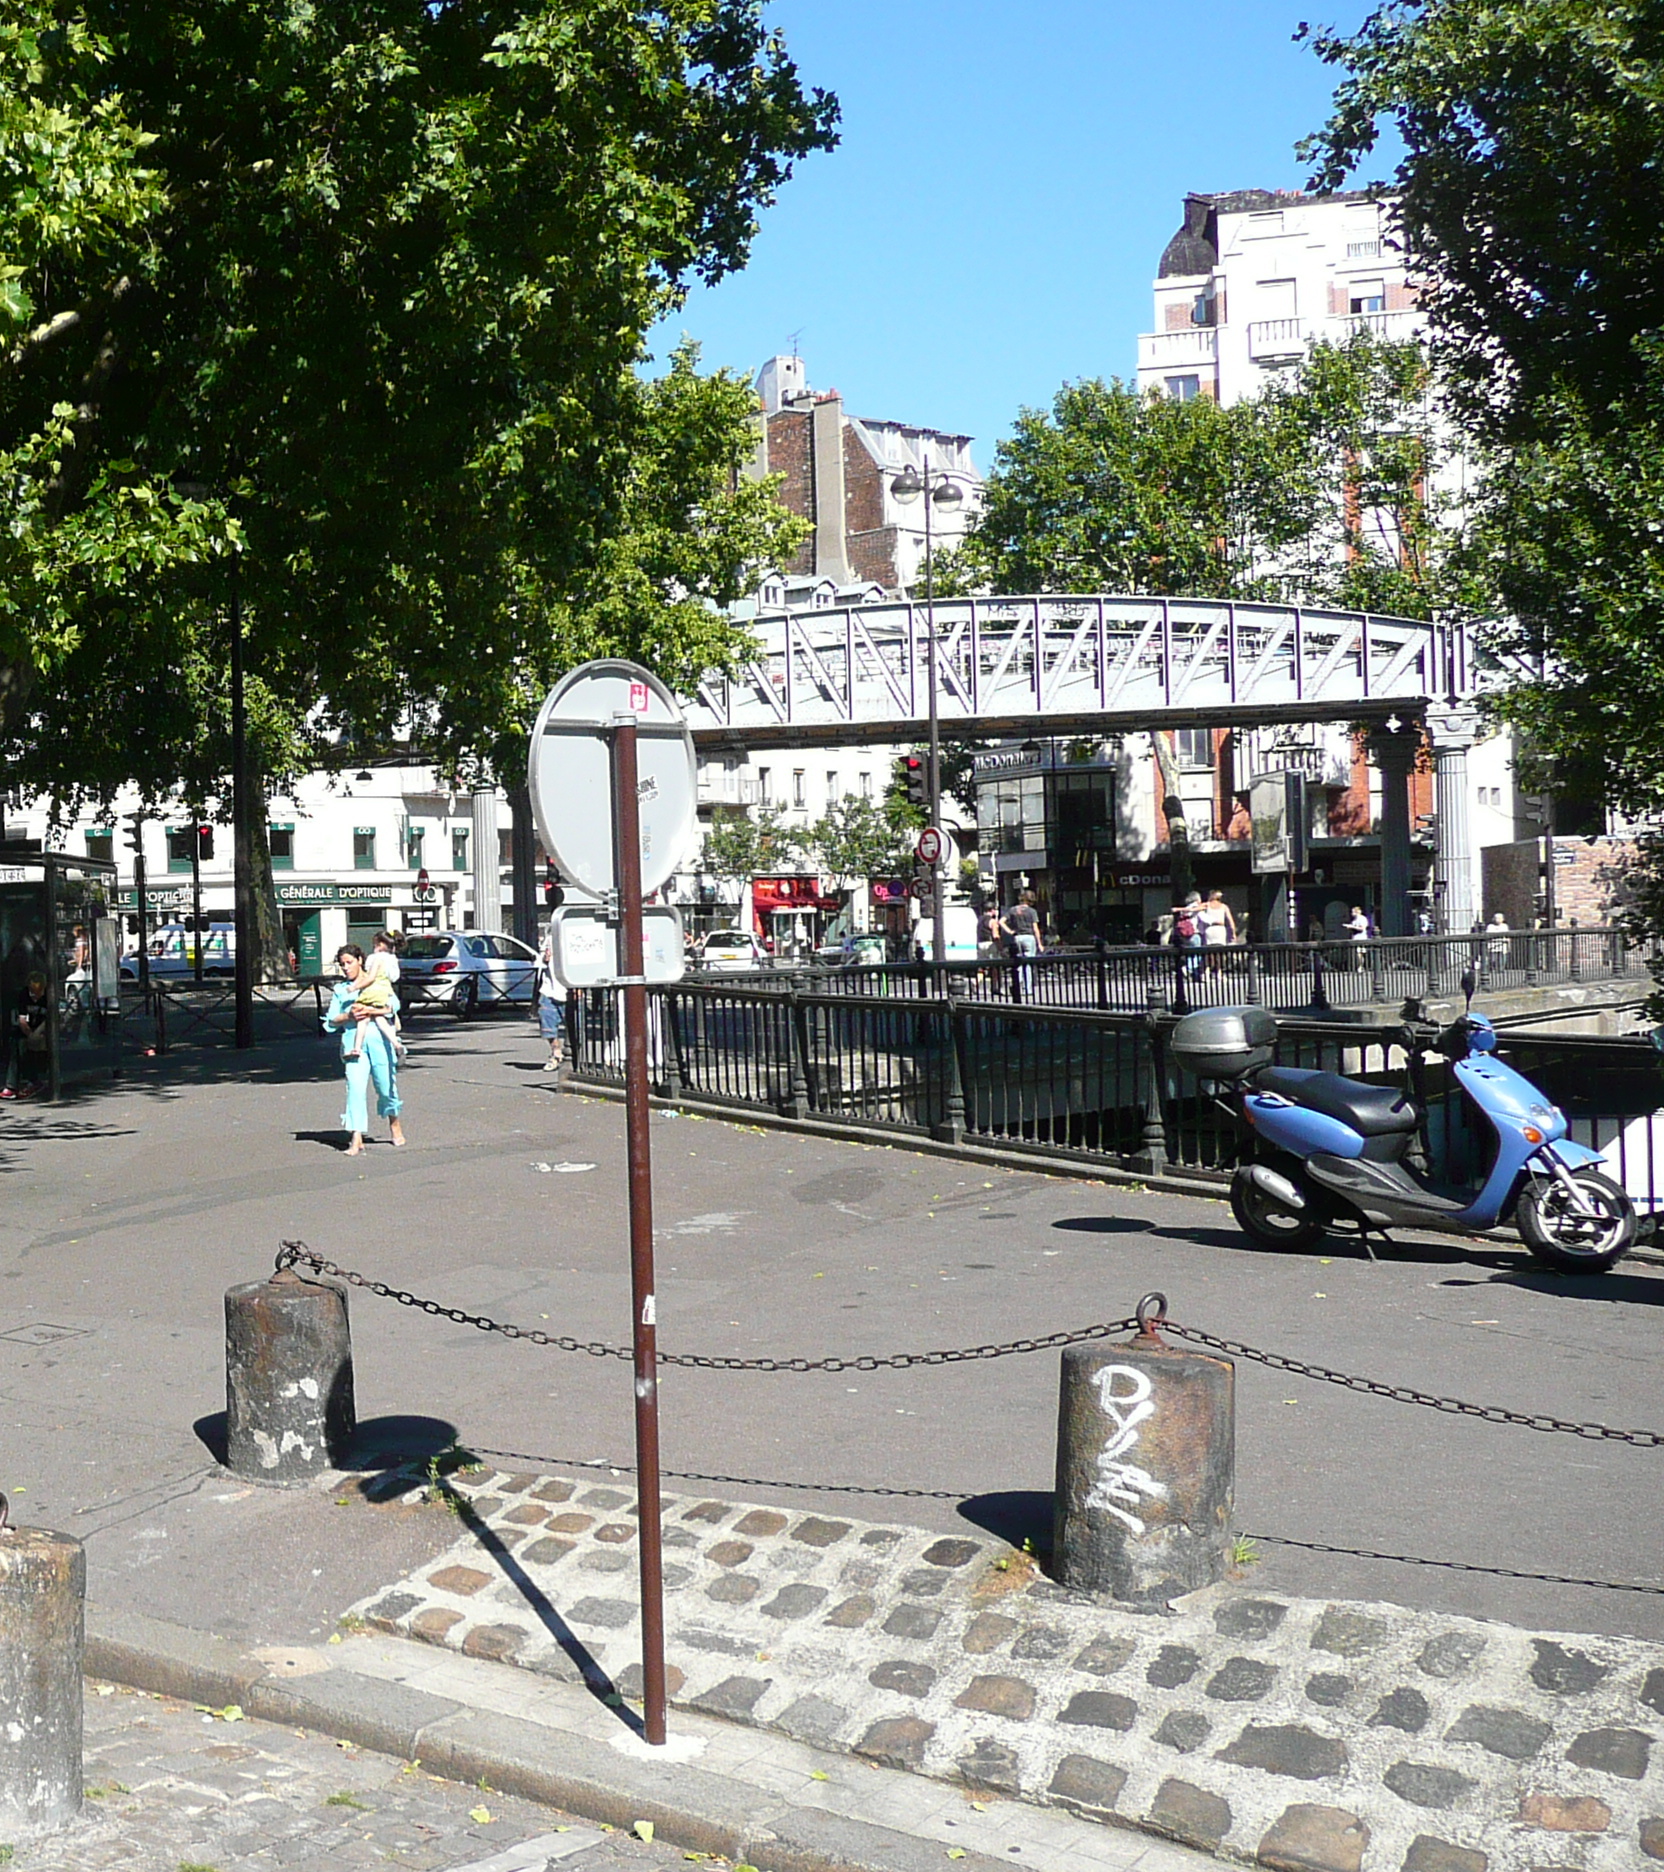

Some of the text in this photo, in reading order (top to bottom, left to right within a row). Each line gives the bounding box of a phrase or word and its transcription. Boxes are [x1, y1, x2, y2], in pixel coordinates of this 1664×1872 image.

[974, 750, 1040, 771] McDonal
[281, 885, 333, 899] GÉNÉRALE
[339, 886, 392, 899] D'OPTIQUE
